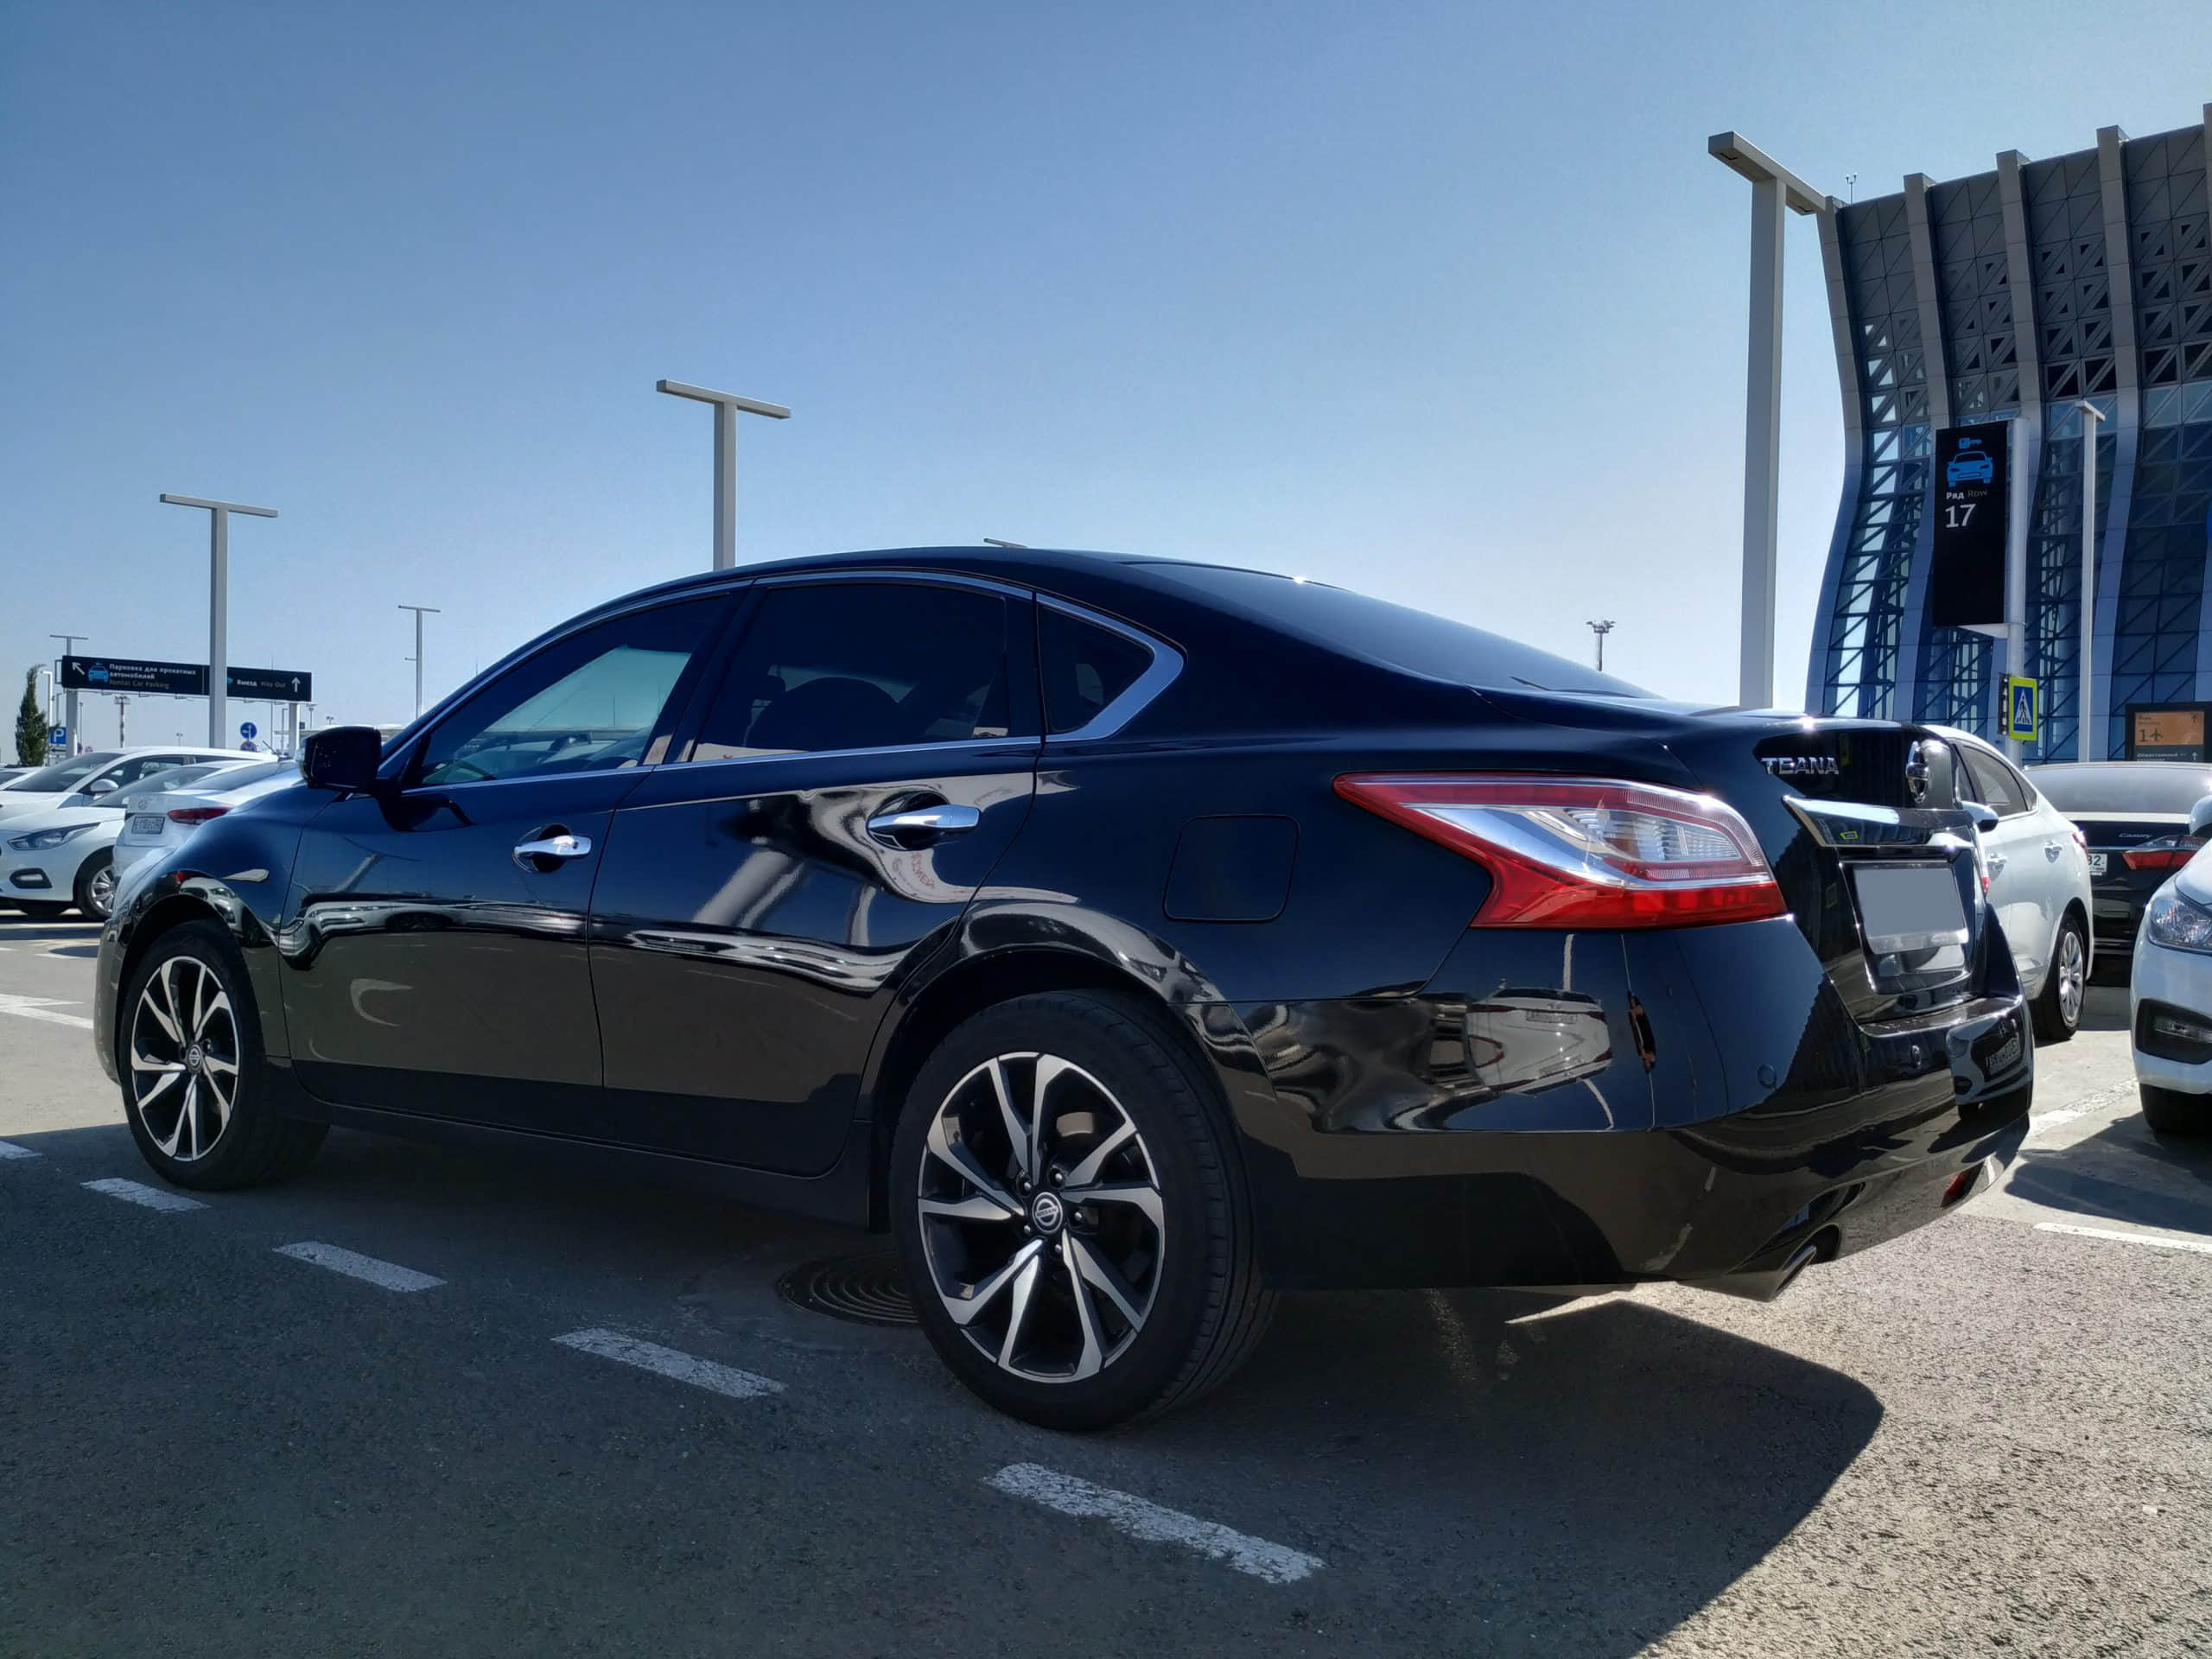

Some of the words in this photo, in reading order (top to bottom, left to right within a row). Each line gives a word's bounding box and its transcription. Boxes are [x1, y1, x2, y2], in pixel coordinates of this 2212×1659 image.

[1945, 504, 1976, 528] 17
[54, 728, 65, 743] P
[1761, 757, 1839, 775] TEANA
